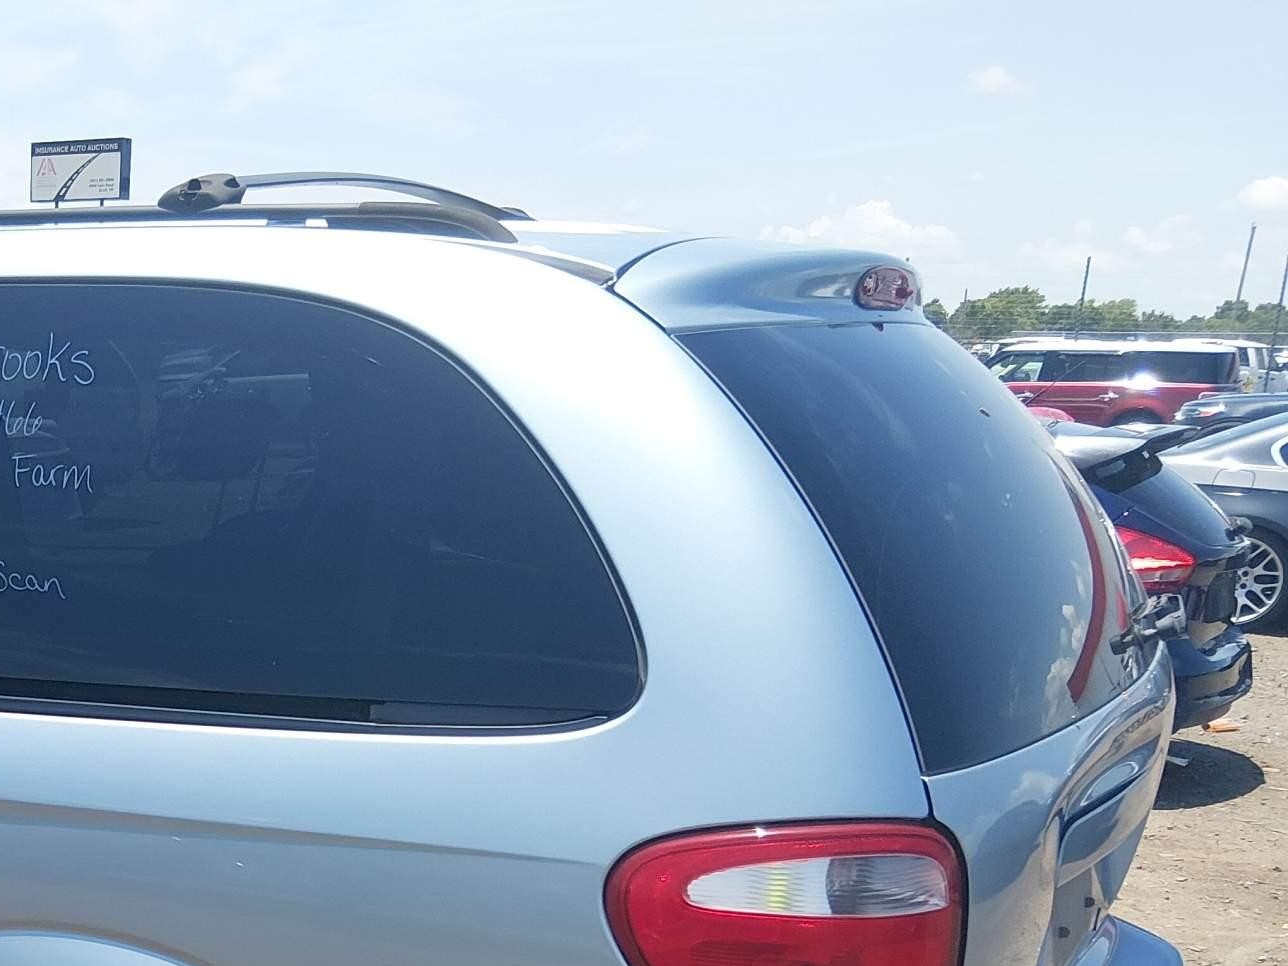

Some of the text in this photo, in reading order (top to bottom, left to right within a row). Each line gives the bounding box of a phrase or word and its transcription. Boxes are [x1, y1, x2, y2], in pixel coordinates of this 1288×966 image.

[35, 143, 119, 154] INSURANCE AUTO AUCTIONS
[12, 452, 93, 494] Farm
